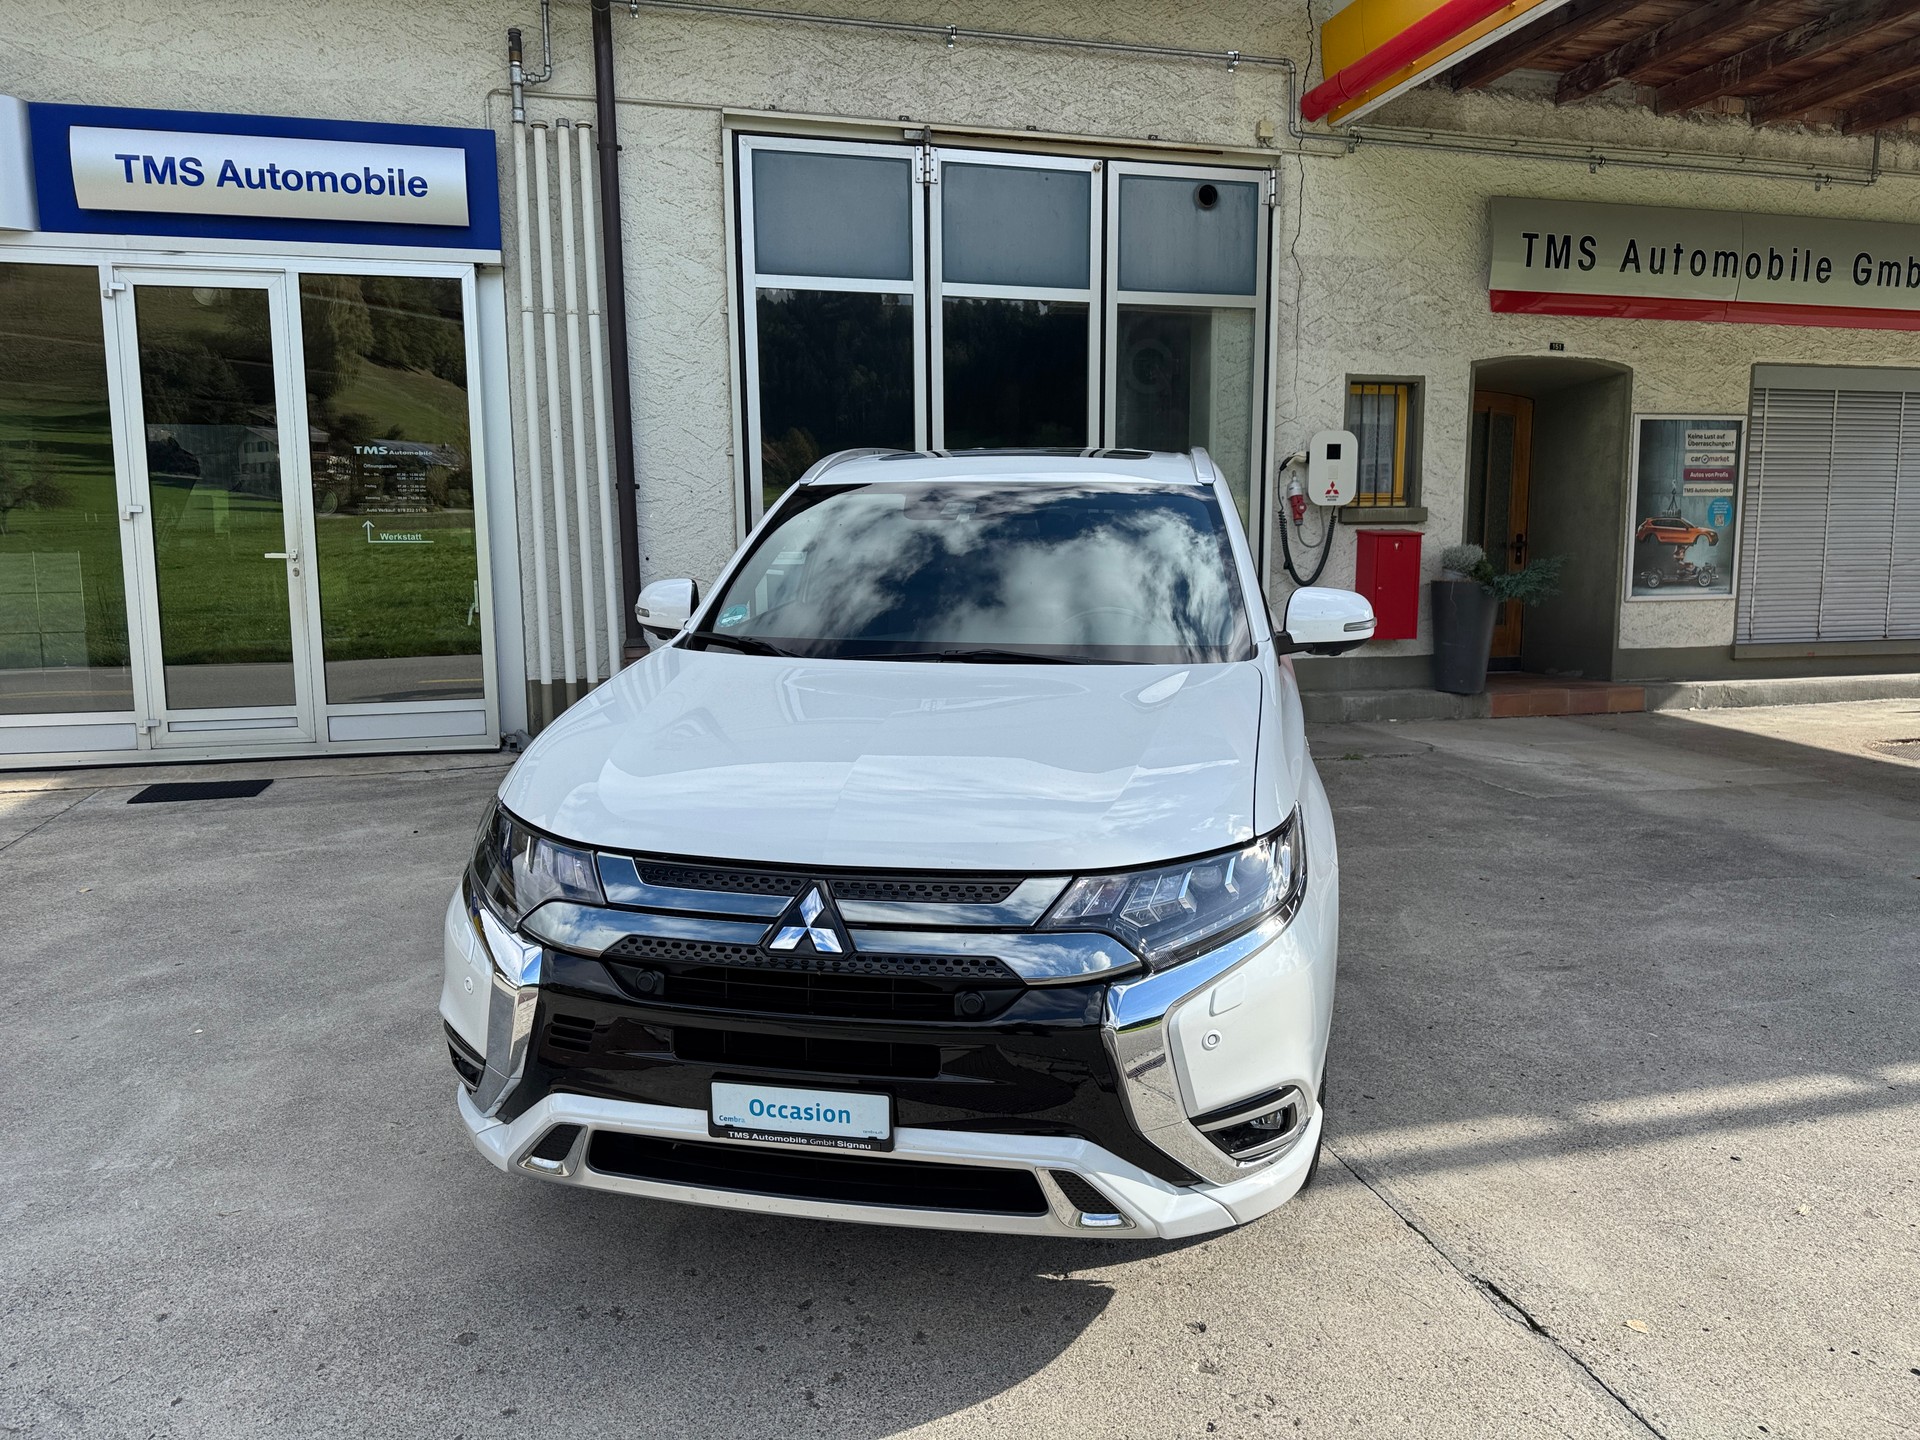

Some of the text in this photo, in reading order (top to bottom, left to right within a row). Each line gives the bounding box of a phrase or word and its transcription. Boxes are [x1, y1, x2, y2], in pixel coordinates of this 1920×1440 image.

[115, 153, 429, 198] TMS Automobile
[1522, 232, 1598, 271] TMS
[1619, 239, 1833, 284] Automobile
[353, 445, 388, 455] TMS
[1688, 440, 1734, 448] Überraschungen?
[380, 532, 422, 541] Werkstatt
[749, 1098, 851, 1124] Occasion
[728, 1131, 872, 1150] TMS Automobile GmbH Signau
